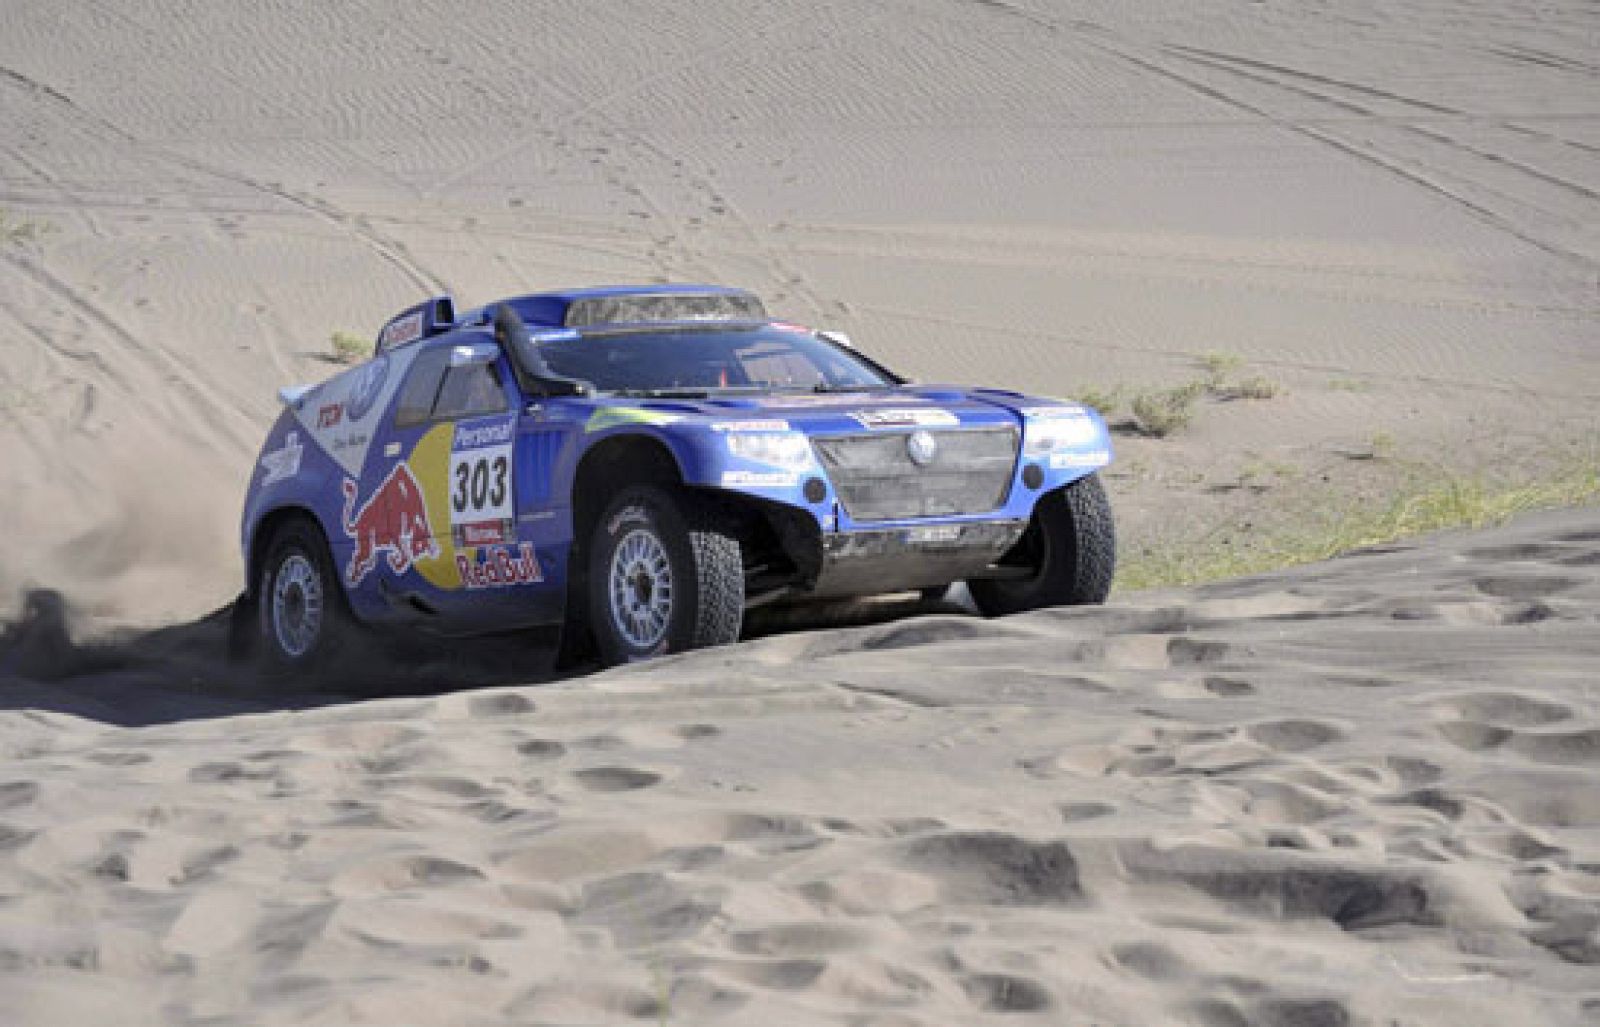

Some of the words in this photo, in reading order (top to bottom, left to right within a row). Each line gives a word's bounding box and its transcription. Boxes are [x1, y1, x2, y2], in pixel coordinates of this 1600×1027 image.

[455, 421, 513, 448] Personal
[453, 456, 508, 512] 303
[455, 547, 496, 592] Red
[495, 541, 544, 586] Bull
